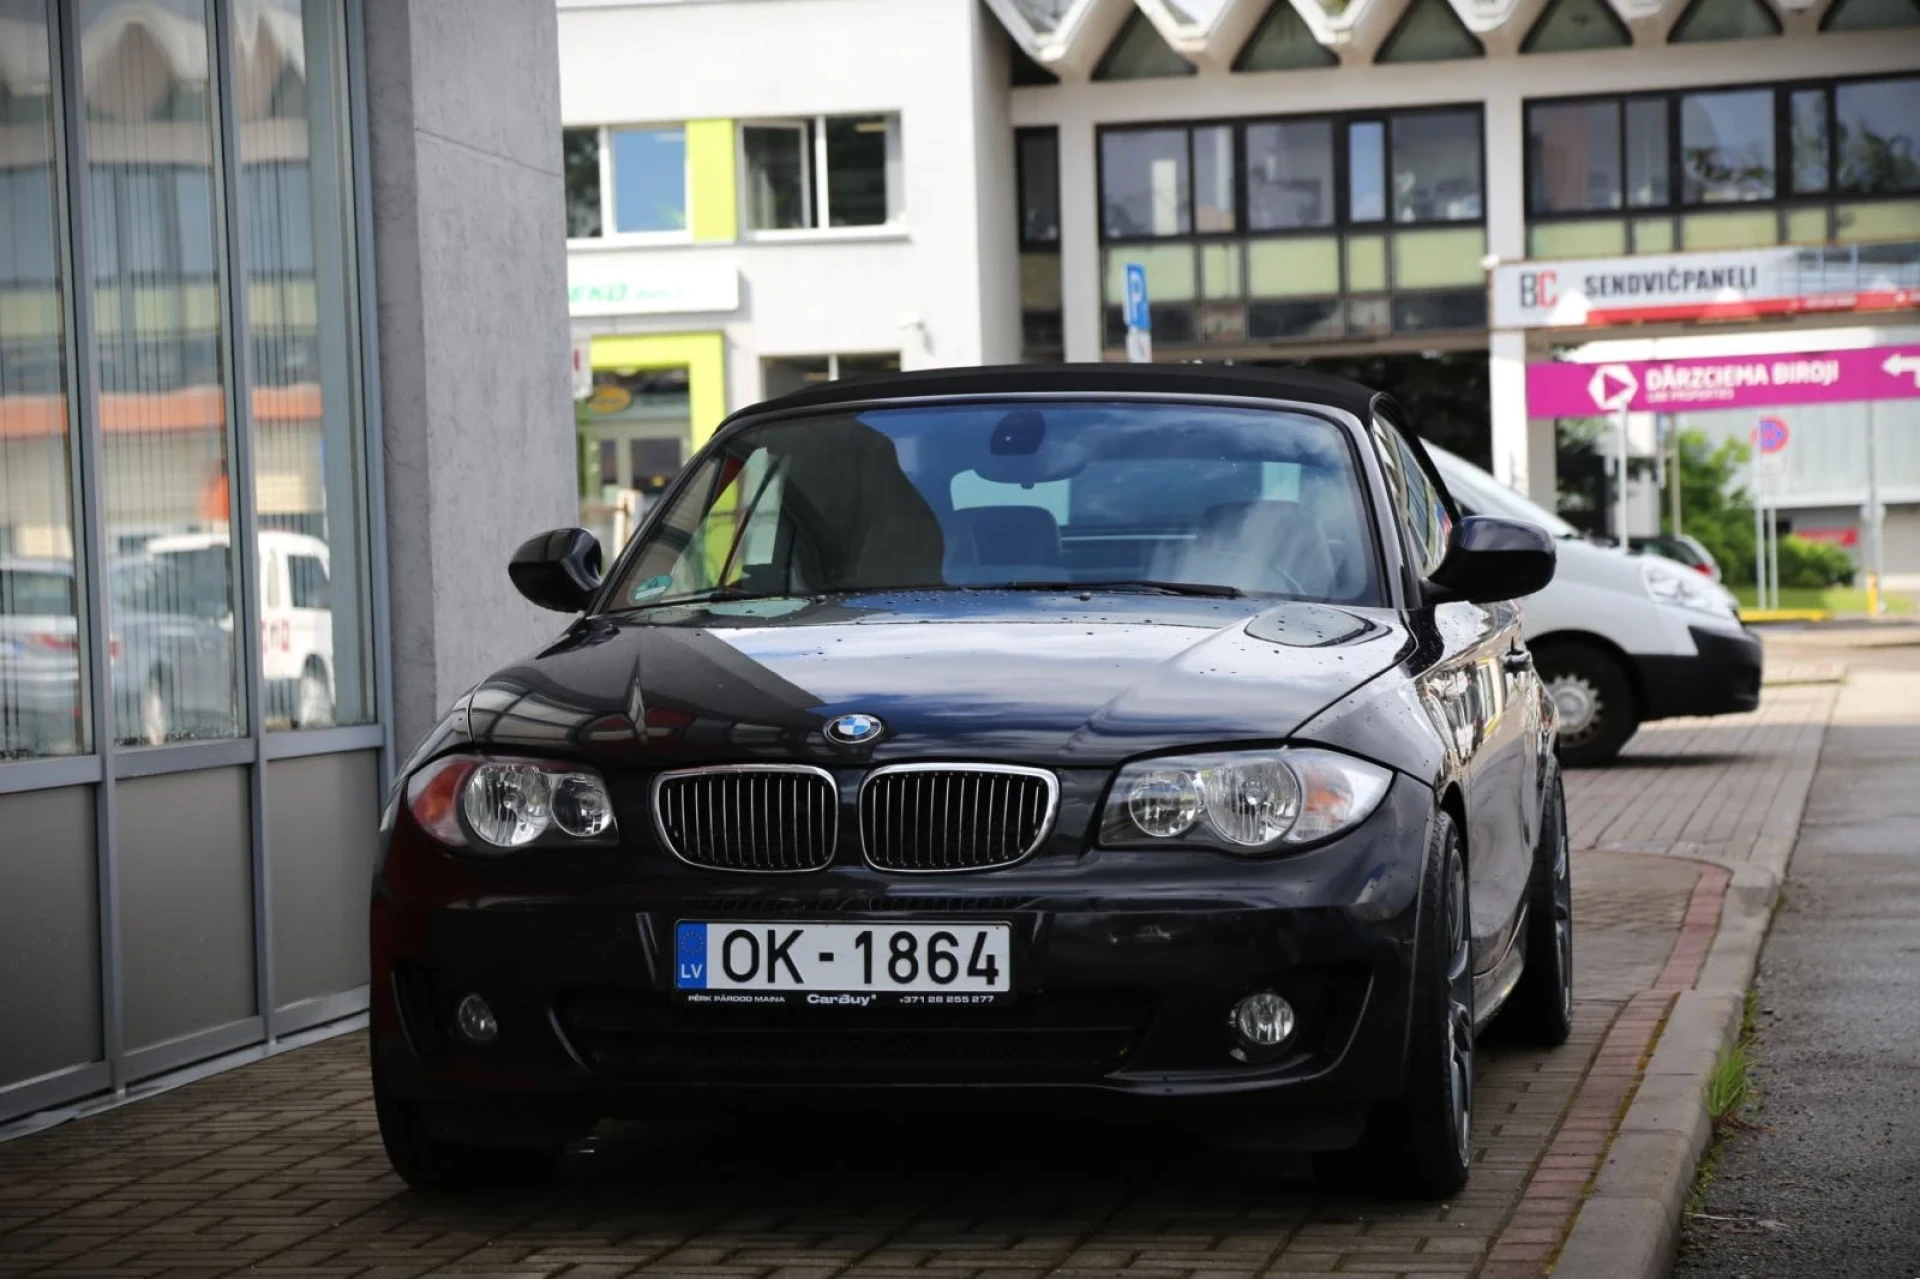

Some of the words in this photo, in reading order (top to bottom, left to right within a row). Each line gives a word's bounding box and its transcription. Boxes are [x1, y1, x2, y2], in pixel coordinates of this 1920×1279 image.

[1128, 270, 1144, 320] P
[1520, 270, 1558, 308] BC
[1772, 359, 1840, 386] BIROJI
[681, 963, 703, 979] LV
